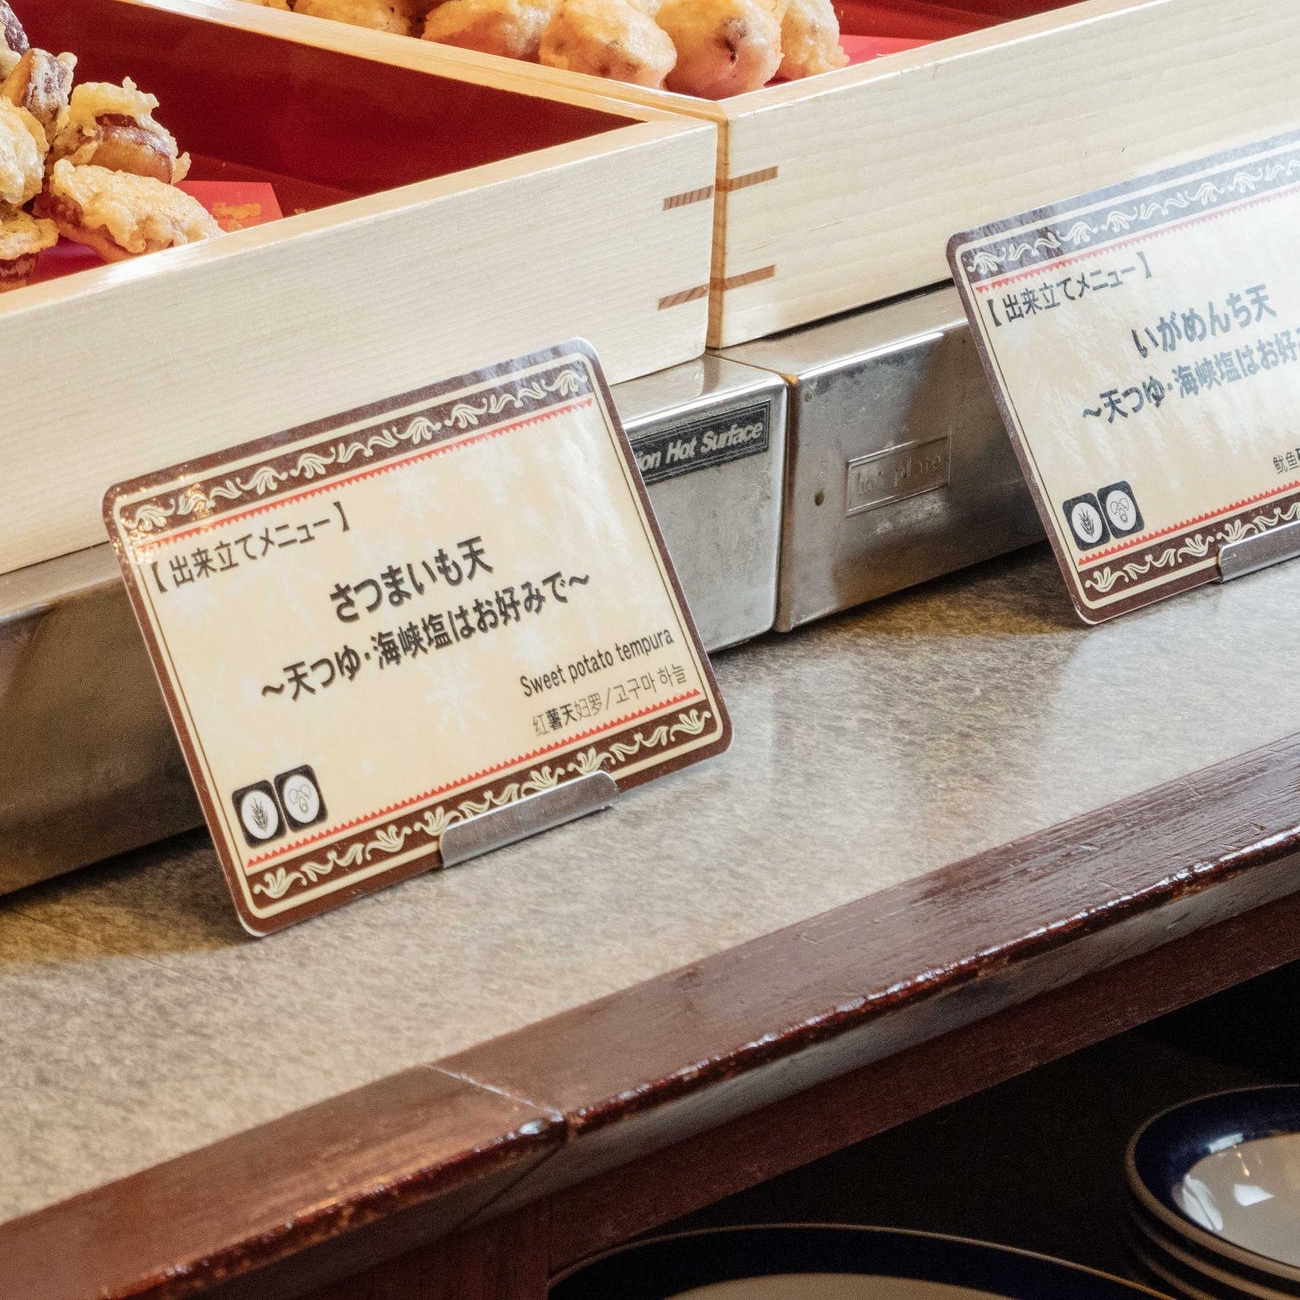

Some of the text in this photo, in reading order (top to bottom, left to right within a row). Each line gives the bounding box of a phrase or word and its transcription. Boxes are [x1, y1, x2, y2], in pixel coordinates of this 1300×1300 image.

[989, 250, 1152, 328] 【出来立てメニュー】
[1131, 283, 1277, 359] いがめんち天
[665, 436, 697, 464] Hot
[700, 421, 764, 454] Surface
[1272, 448, 1300, 475] 鱿鱼
[150, 501, 351, 595] 【出来立てメニュー】
[329, 535, 495, 623] さつまいも天
[519, 628, 675, 698] Sweet potato tempura
[657, 663, 688, 687] 하늘
